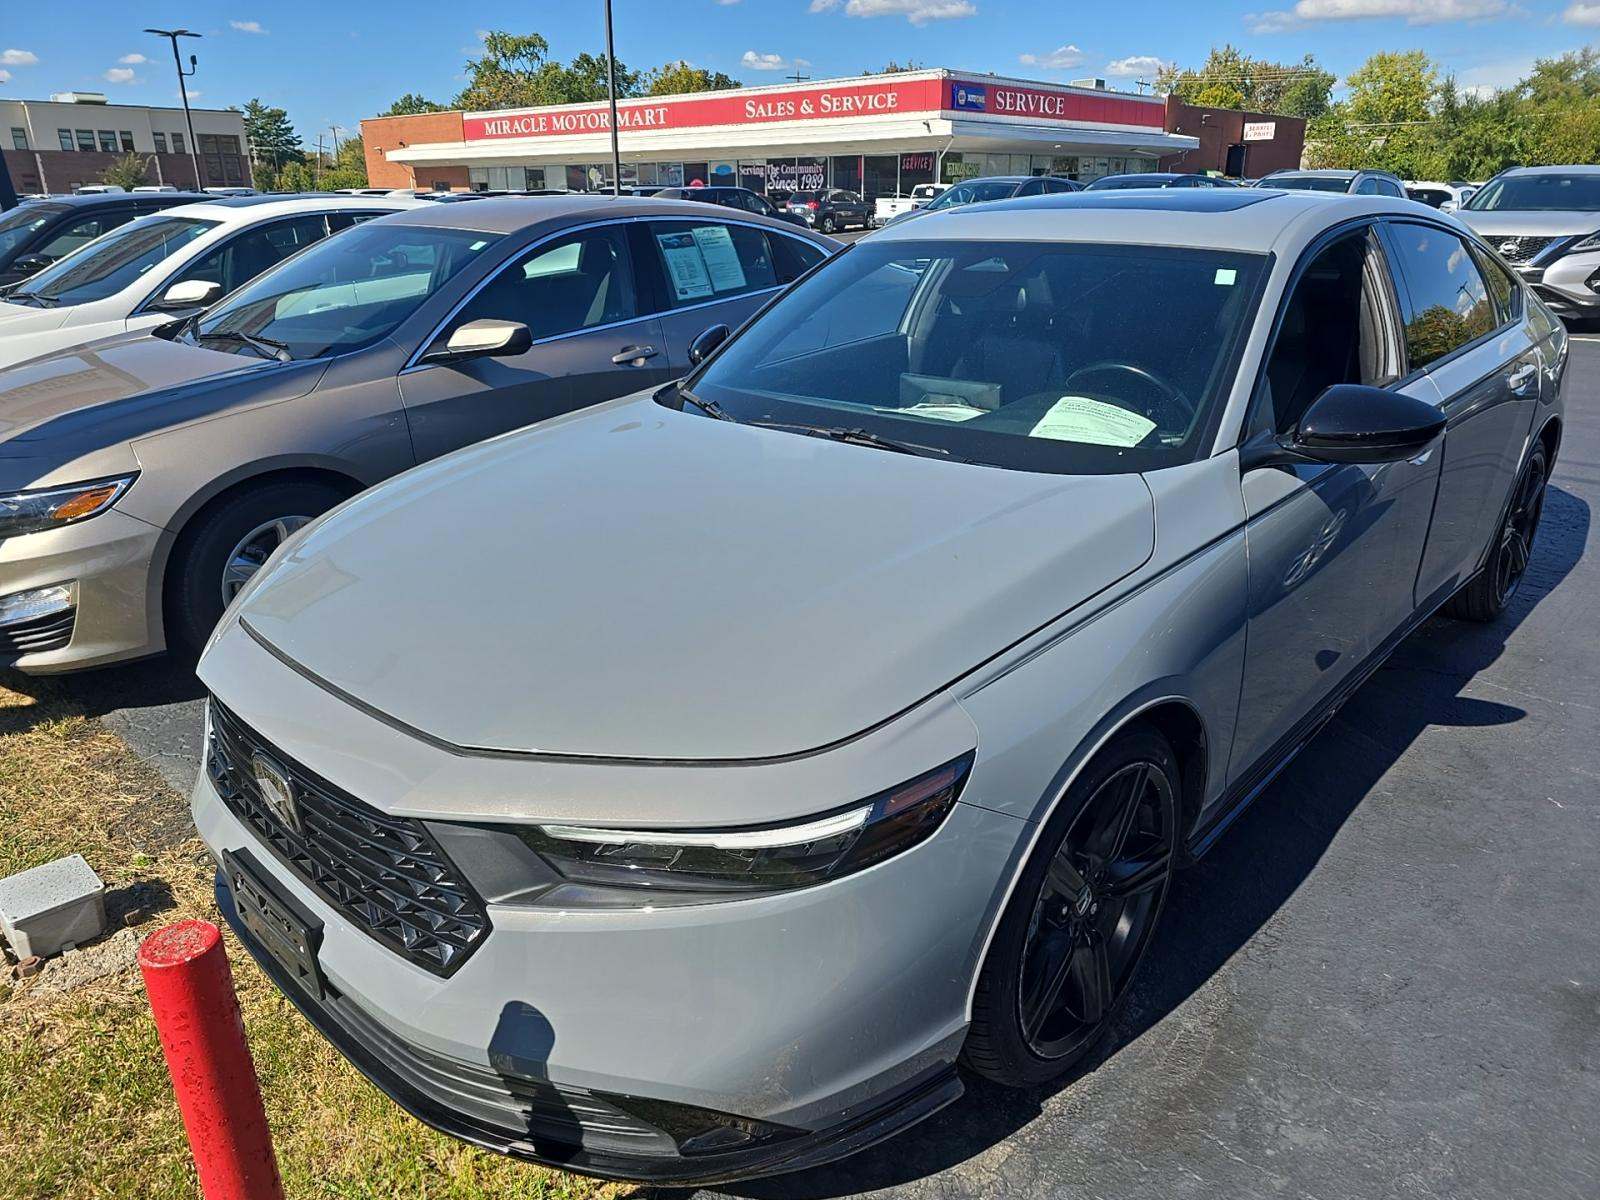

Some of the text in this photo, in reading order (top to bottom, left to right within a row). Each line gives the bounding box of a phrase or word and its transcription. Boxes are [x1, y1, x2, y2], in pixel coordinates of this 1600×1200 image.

[799, 99, 815, 115] &
[995, 90, 1065, 115] SERVICE
[484, 107, 668, 136] MIRACLE MOTOR MART
[739, 163, 824, 178] Serving The Community
[767, 173, 824, 190] Since 1989
